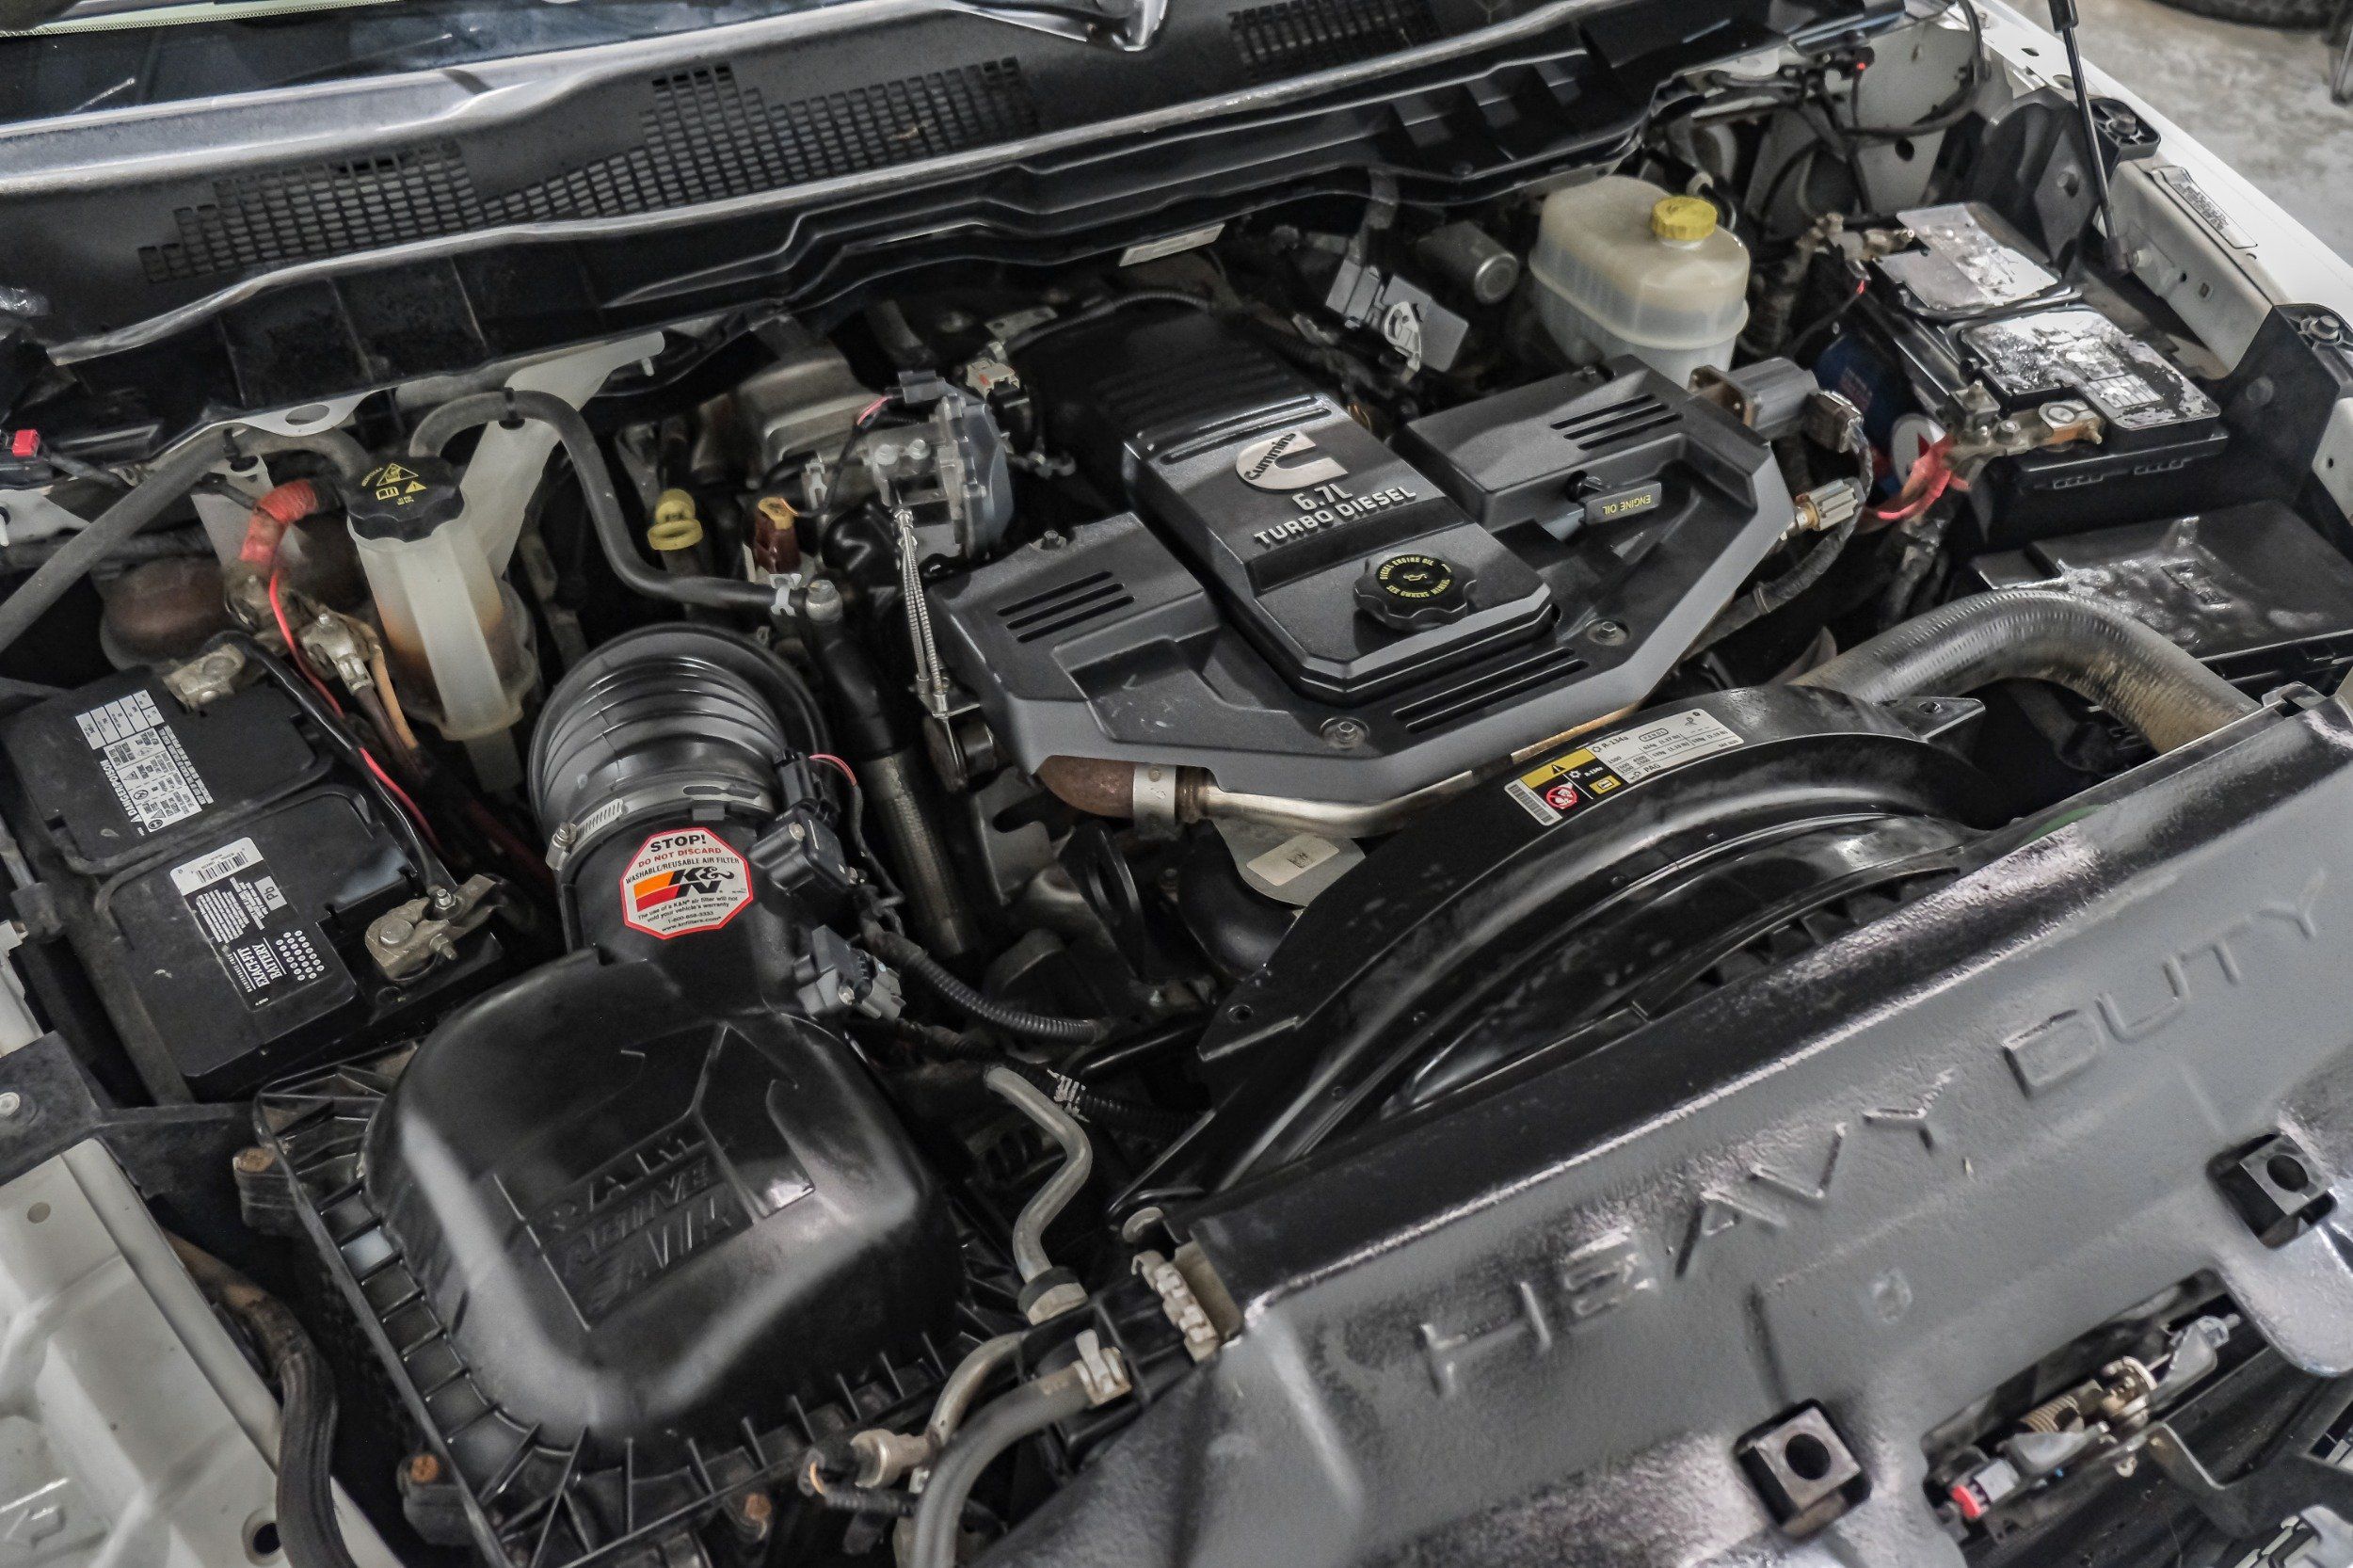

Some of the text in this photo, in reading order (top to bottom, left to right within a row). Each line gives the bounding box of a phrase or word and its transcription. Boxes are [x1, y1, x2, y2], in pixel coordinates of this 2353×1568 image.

[1244, 433, 1296, 481] Cummins
[1292, 483, 1353, 510] 6.7L
[1602, 495, 1651, 515] ENGINE OIL
[1254, 487, 1417, 545] TURBO DIESEL
[651, 835, 706, 852] STOP!
[626, 858, 699, 884] WASHABLE/REUSABLE
[638, 859, 650, 868] DO
[654, 852, 674, 862] NOT
[265, 885, 279, 902] Pb
[236, 947, 269, 987] EXACT-FIT
[251, 943, 282, 980] BATTERY
[1415, 867, 2329, 1400] HEAVY DUTY
